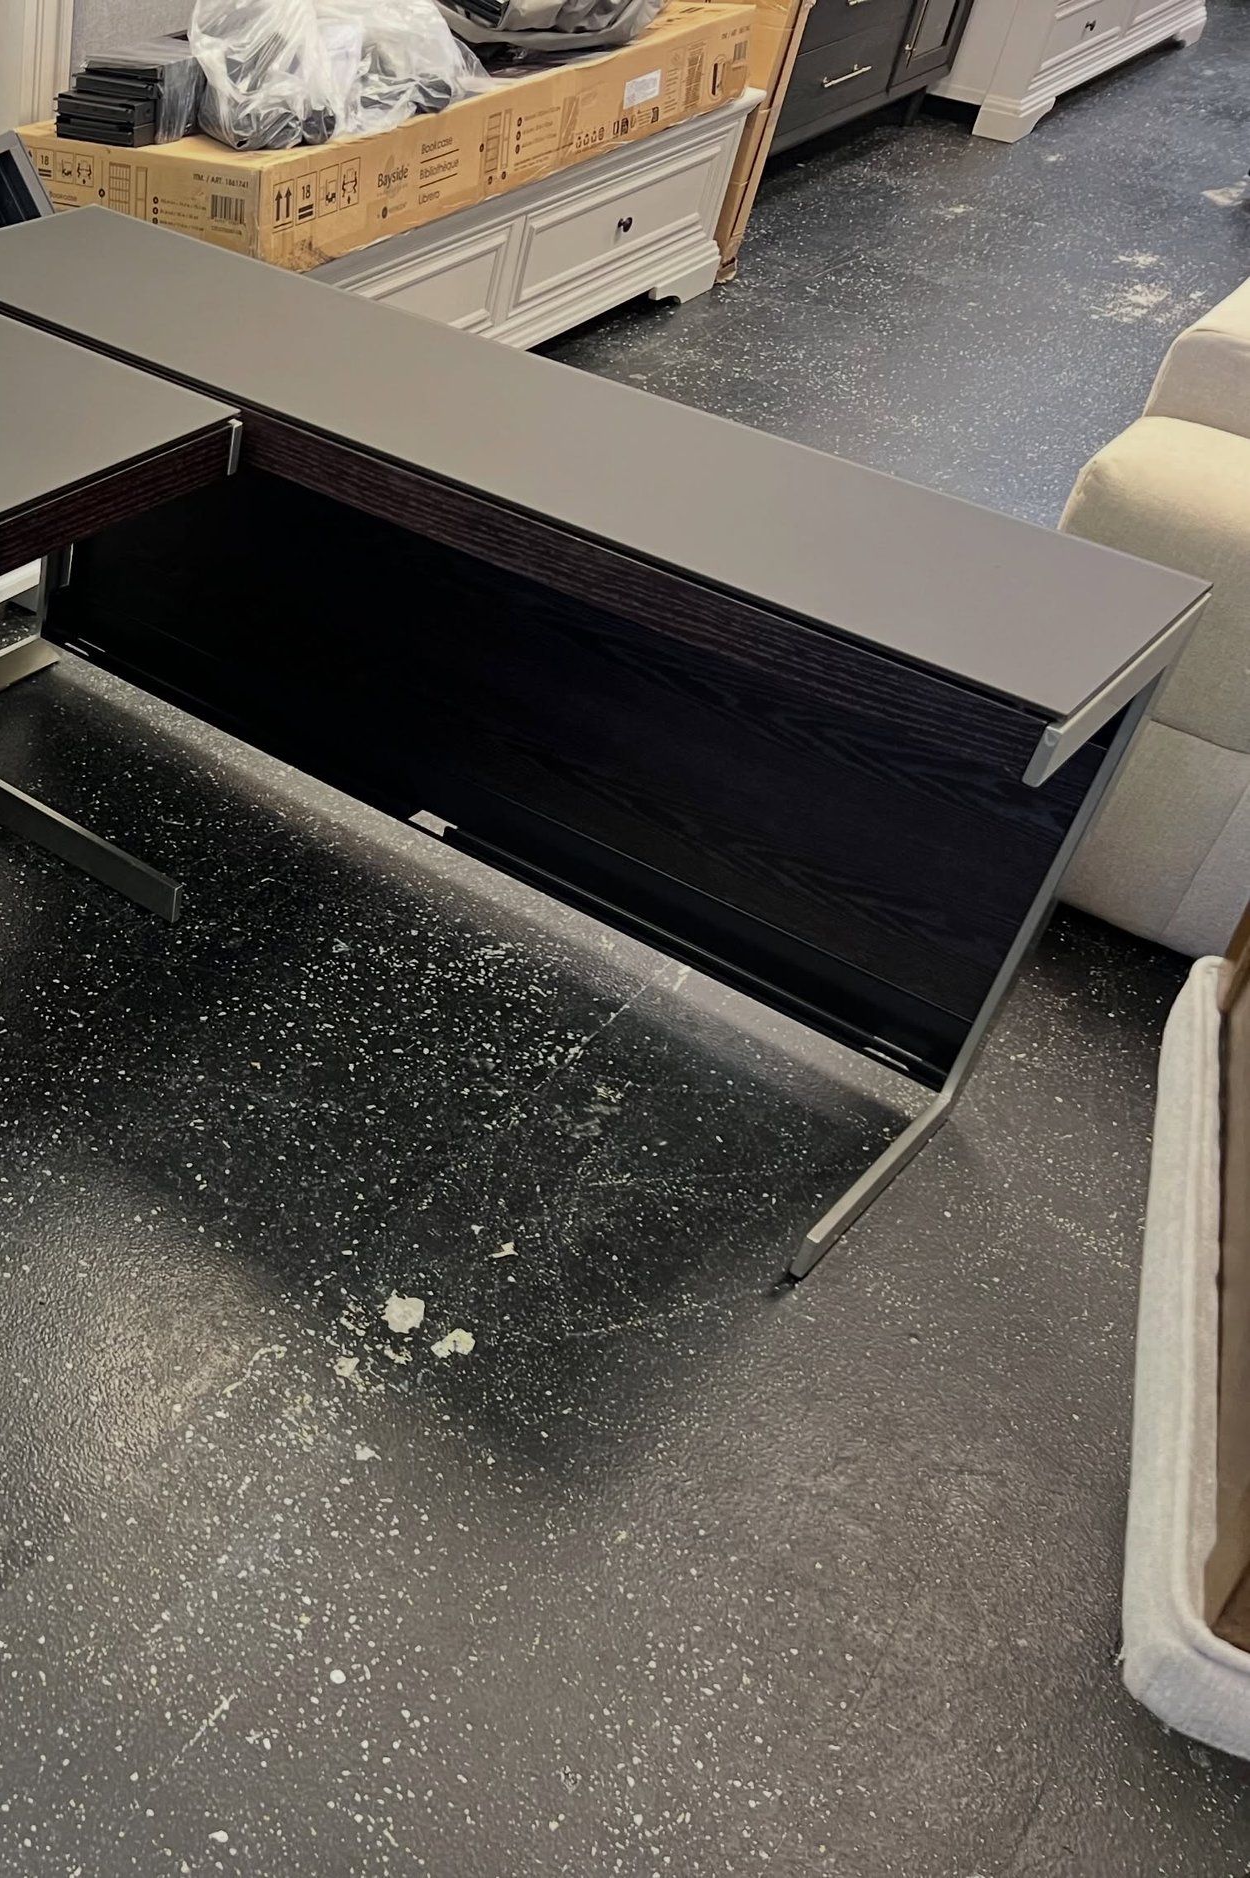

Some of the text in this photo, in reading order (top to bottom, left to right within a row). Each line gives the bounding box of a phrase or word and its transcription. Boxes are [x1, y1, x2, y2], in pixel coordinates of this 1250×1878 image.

[40, 154, 50, 166] 18
[377, 165, 409, 190] Bayside
[302, 184, 311, 200] 18
